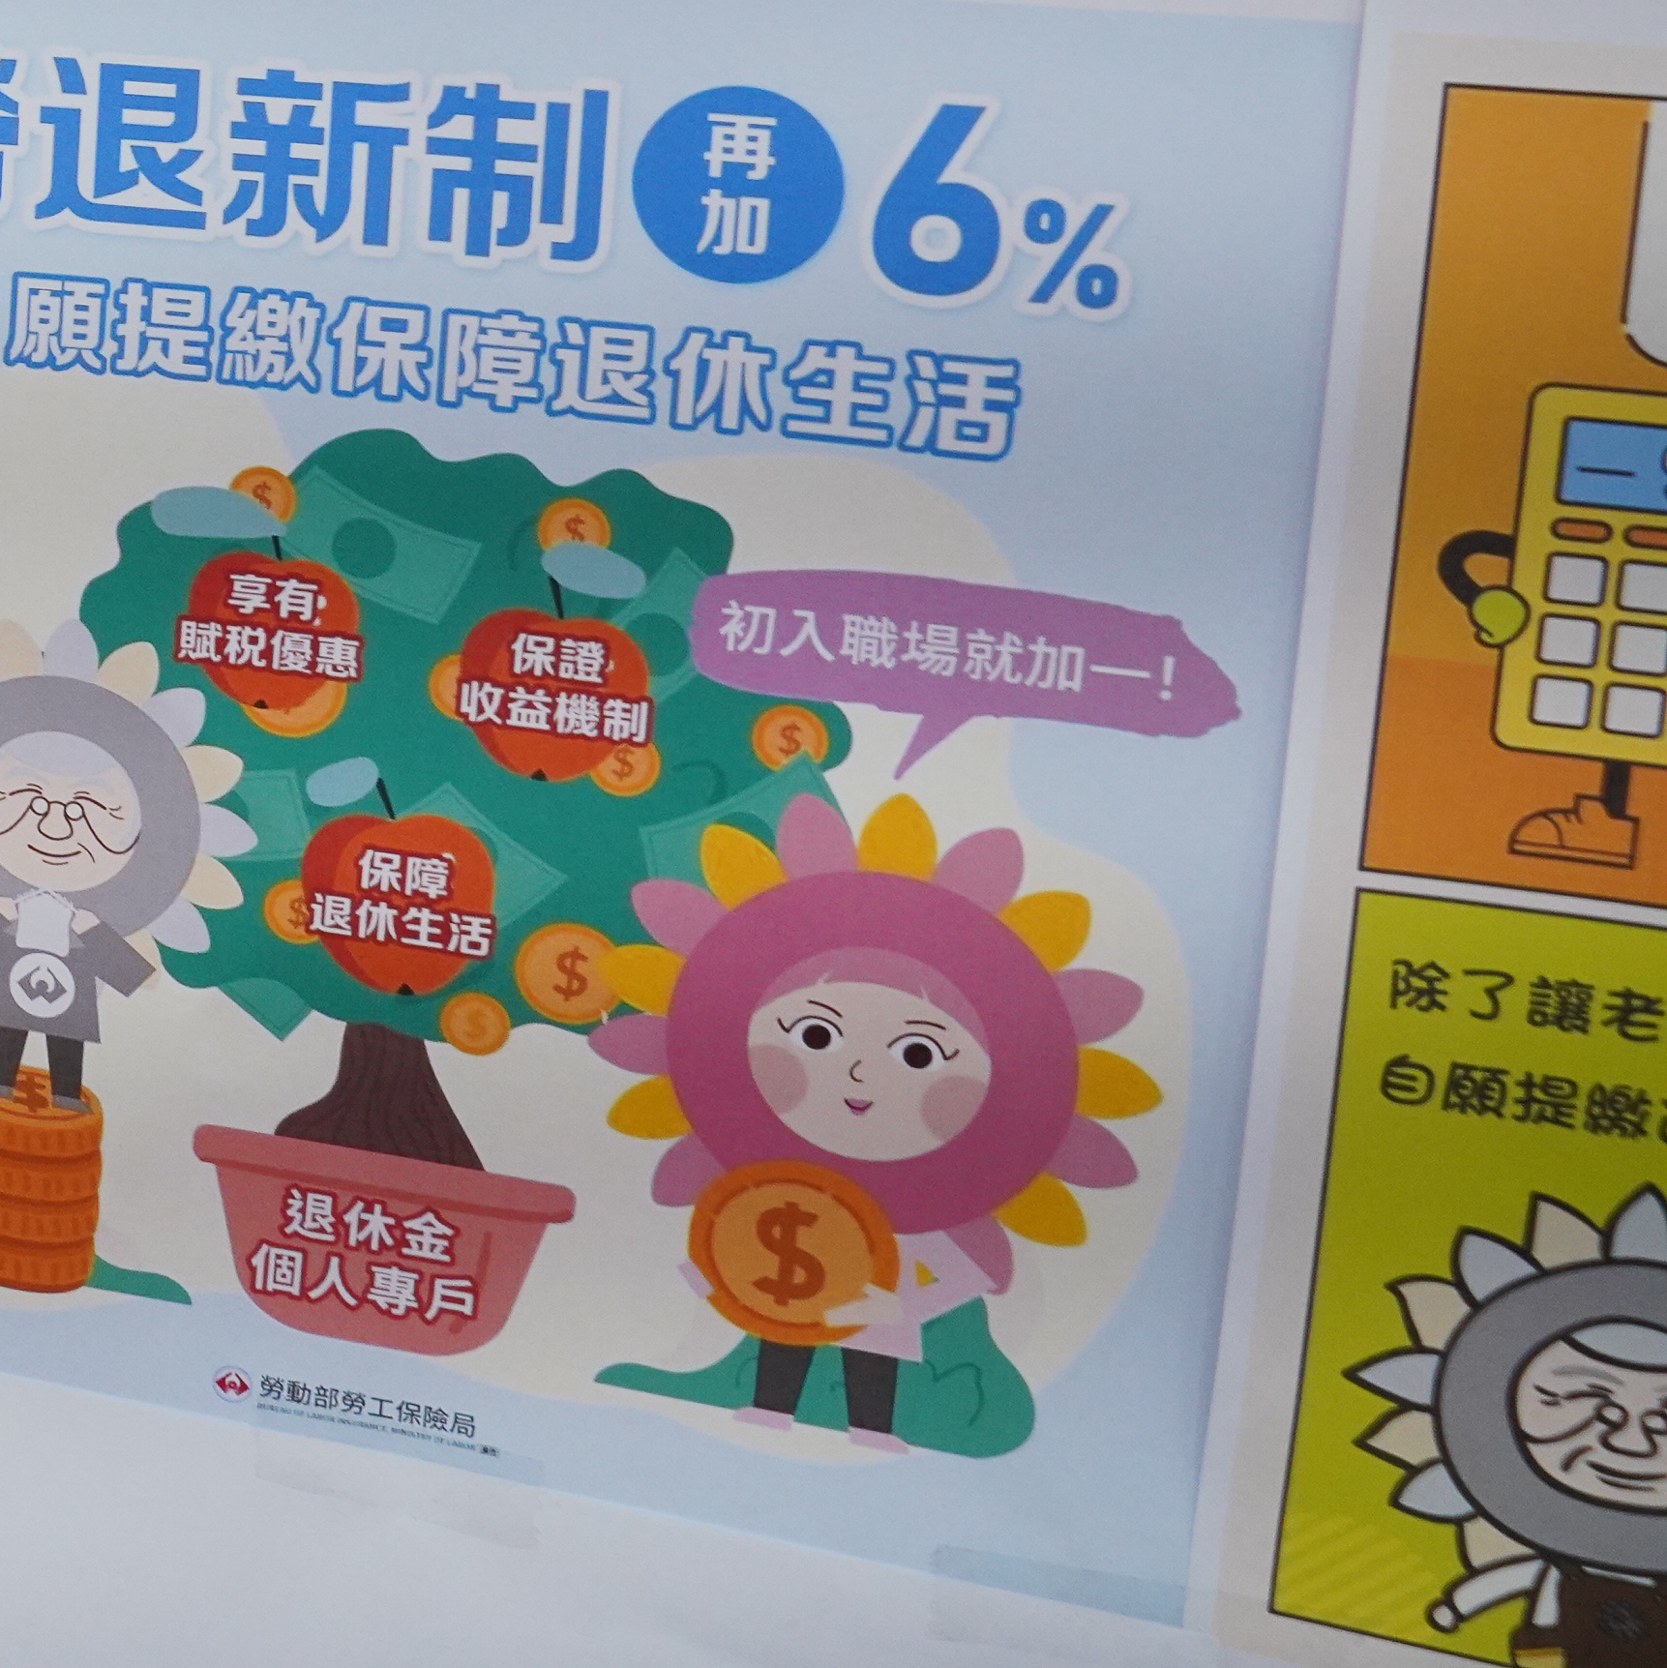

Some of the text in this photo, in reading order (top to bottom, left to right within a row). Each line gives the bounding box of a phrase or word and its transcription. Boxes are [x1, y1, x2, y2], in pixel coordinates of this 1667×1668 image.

[697, 112, 779, 255] 再加
[872, 104, 1119, 309] 6%
[227, 573, 319, 622] 享有
[511, 632, 606, 684] 保證
[459, 680, 650, 744] 收益機制
[358, 849, 450, 900] 保障
[309, 894, 493, 958] 退休生活
[1389, 958, 1665, 1043] 除了讓老
[1380, 1053, 1667, 1144] 自願提繳
[283, 1188, 455, 1263] 退休金
[251, 1243, 476, 1321] 個人專戶
[259, 1374, 476, 1439] 勞動部勞工保險局
